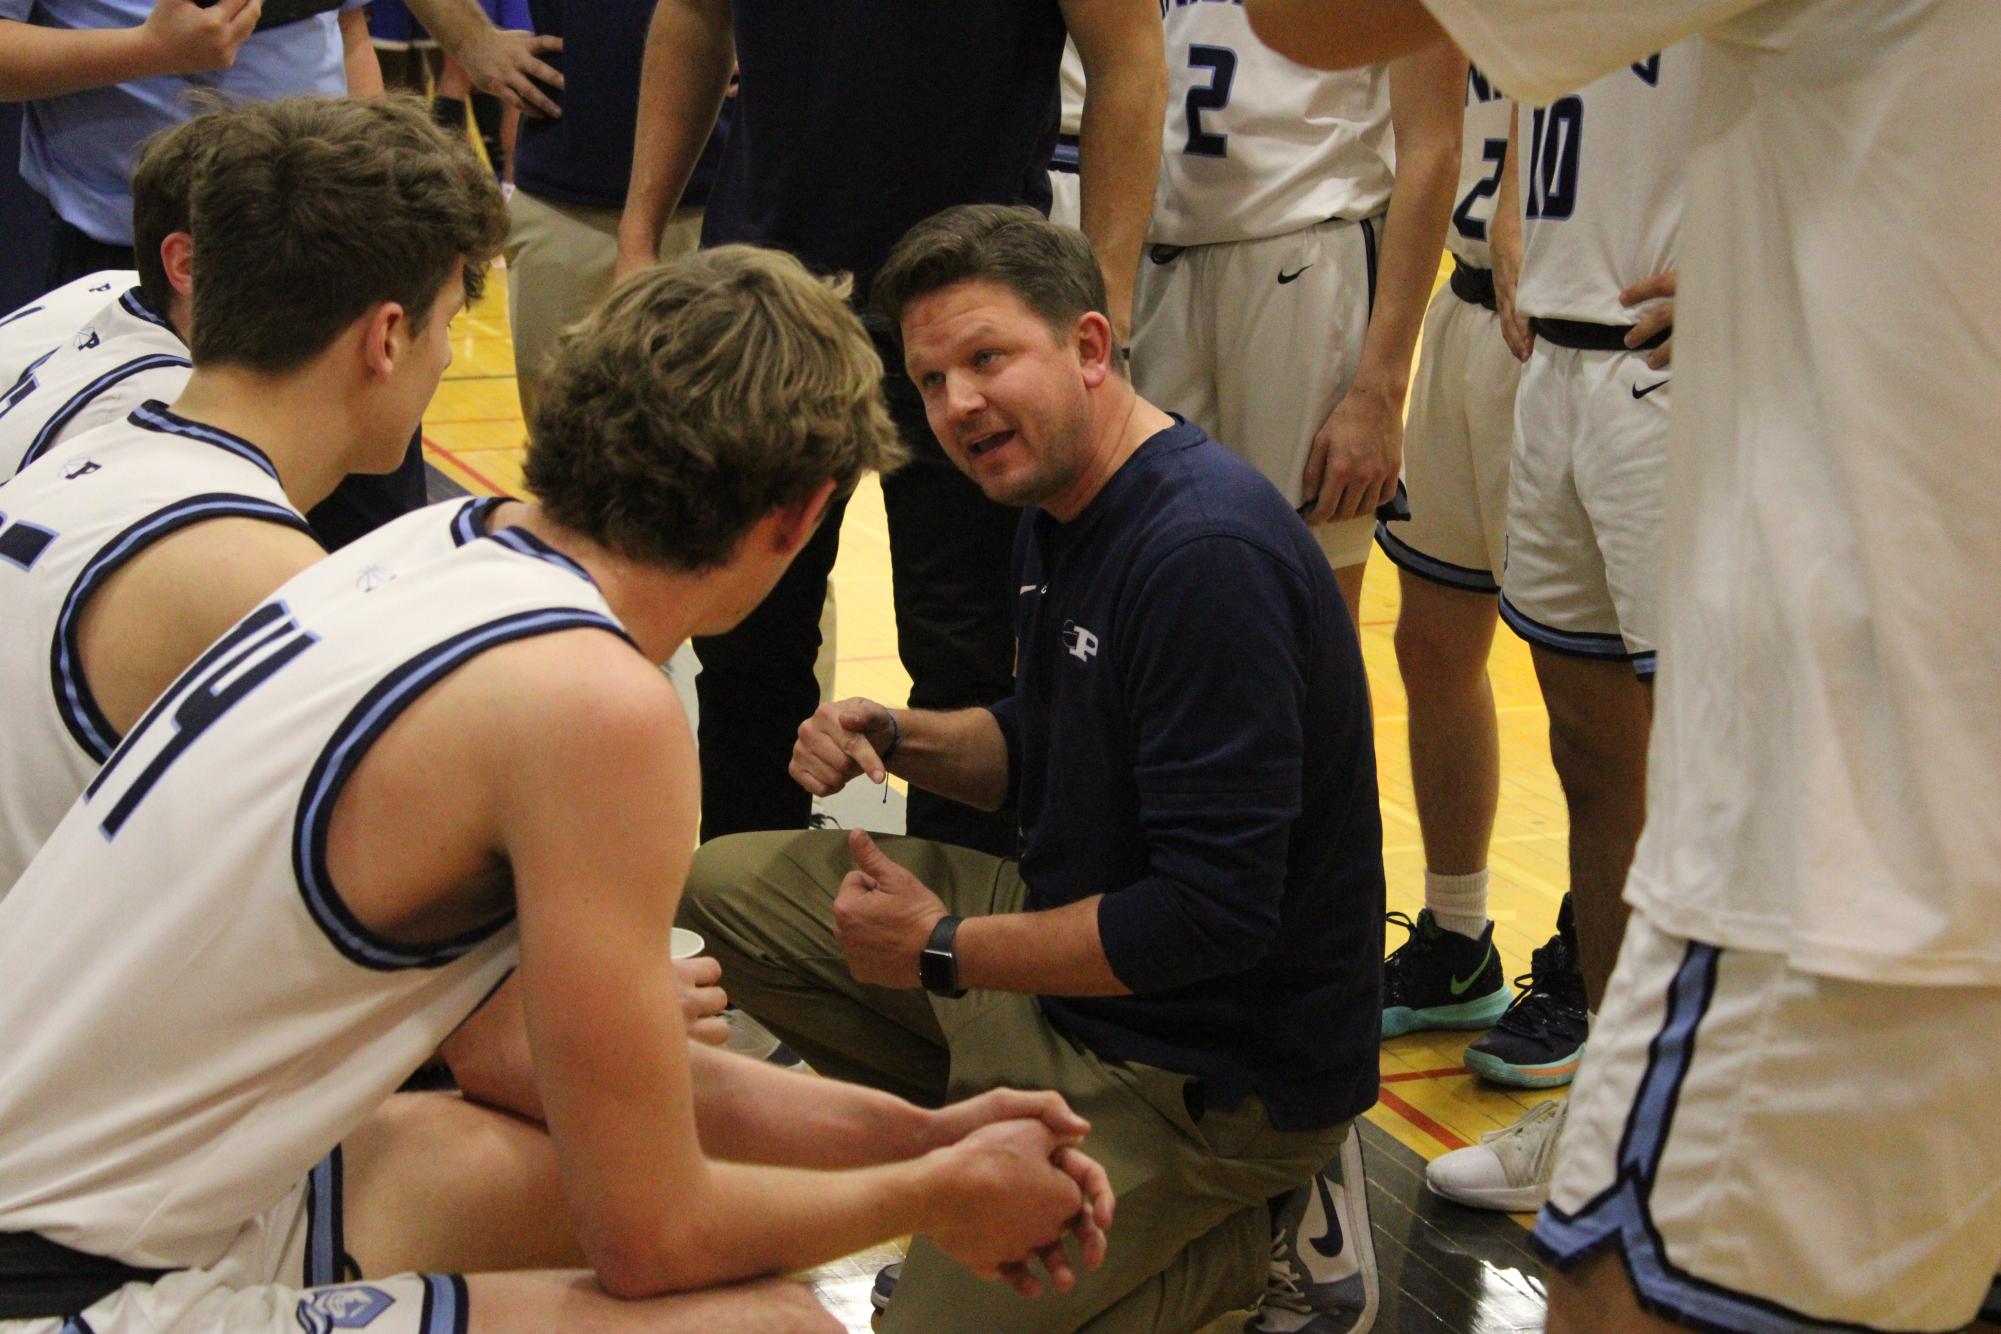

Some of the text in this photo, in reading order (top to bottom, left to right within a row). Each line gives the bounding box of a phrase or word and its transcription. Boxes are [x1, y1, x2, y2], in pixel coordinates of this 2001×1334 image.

[1183, 43, 1238, 158] 2
[1525, 94, 1584, 221] 10
[1068, 624, 1099, 663] P
